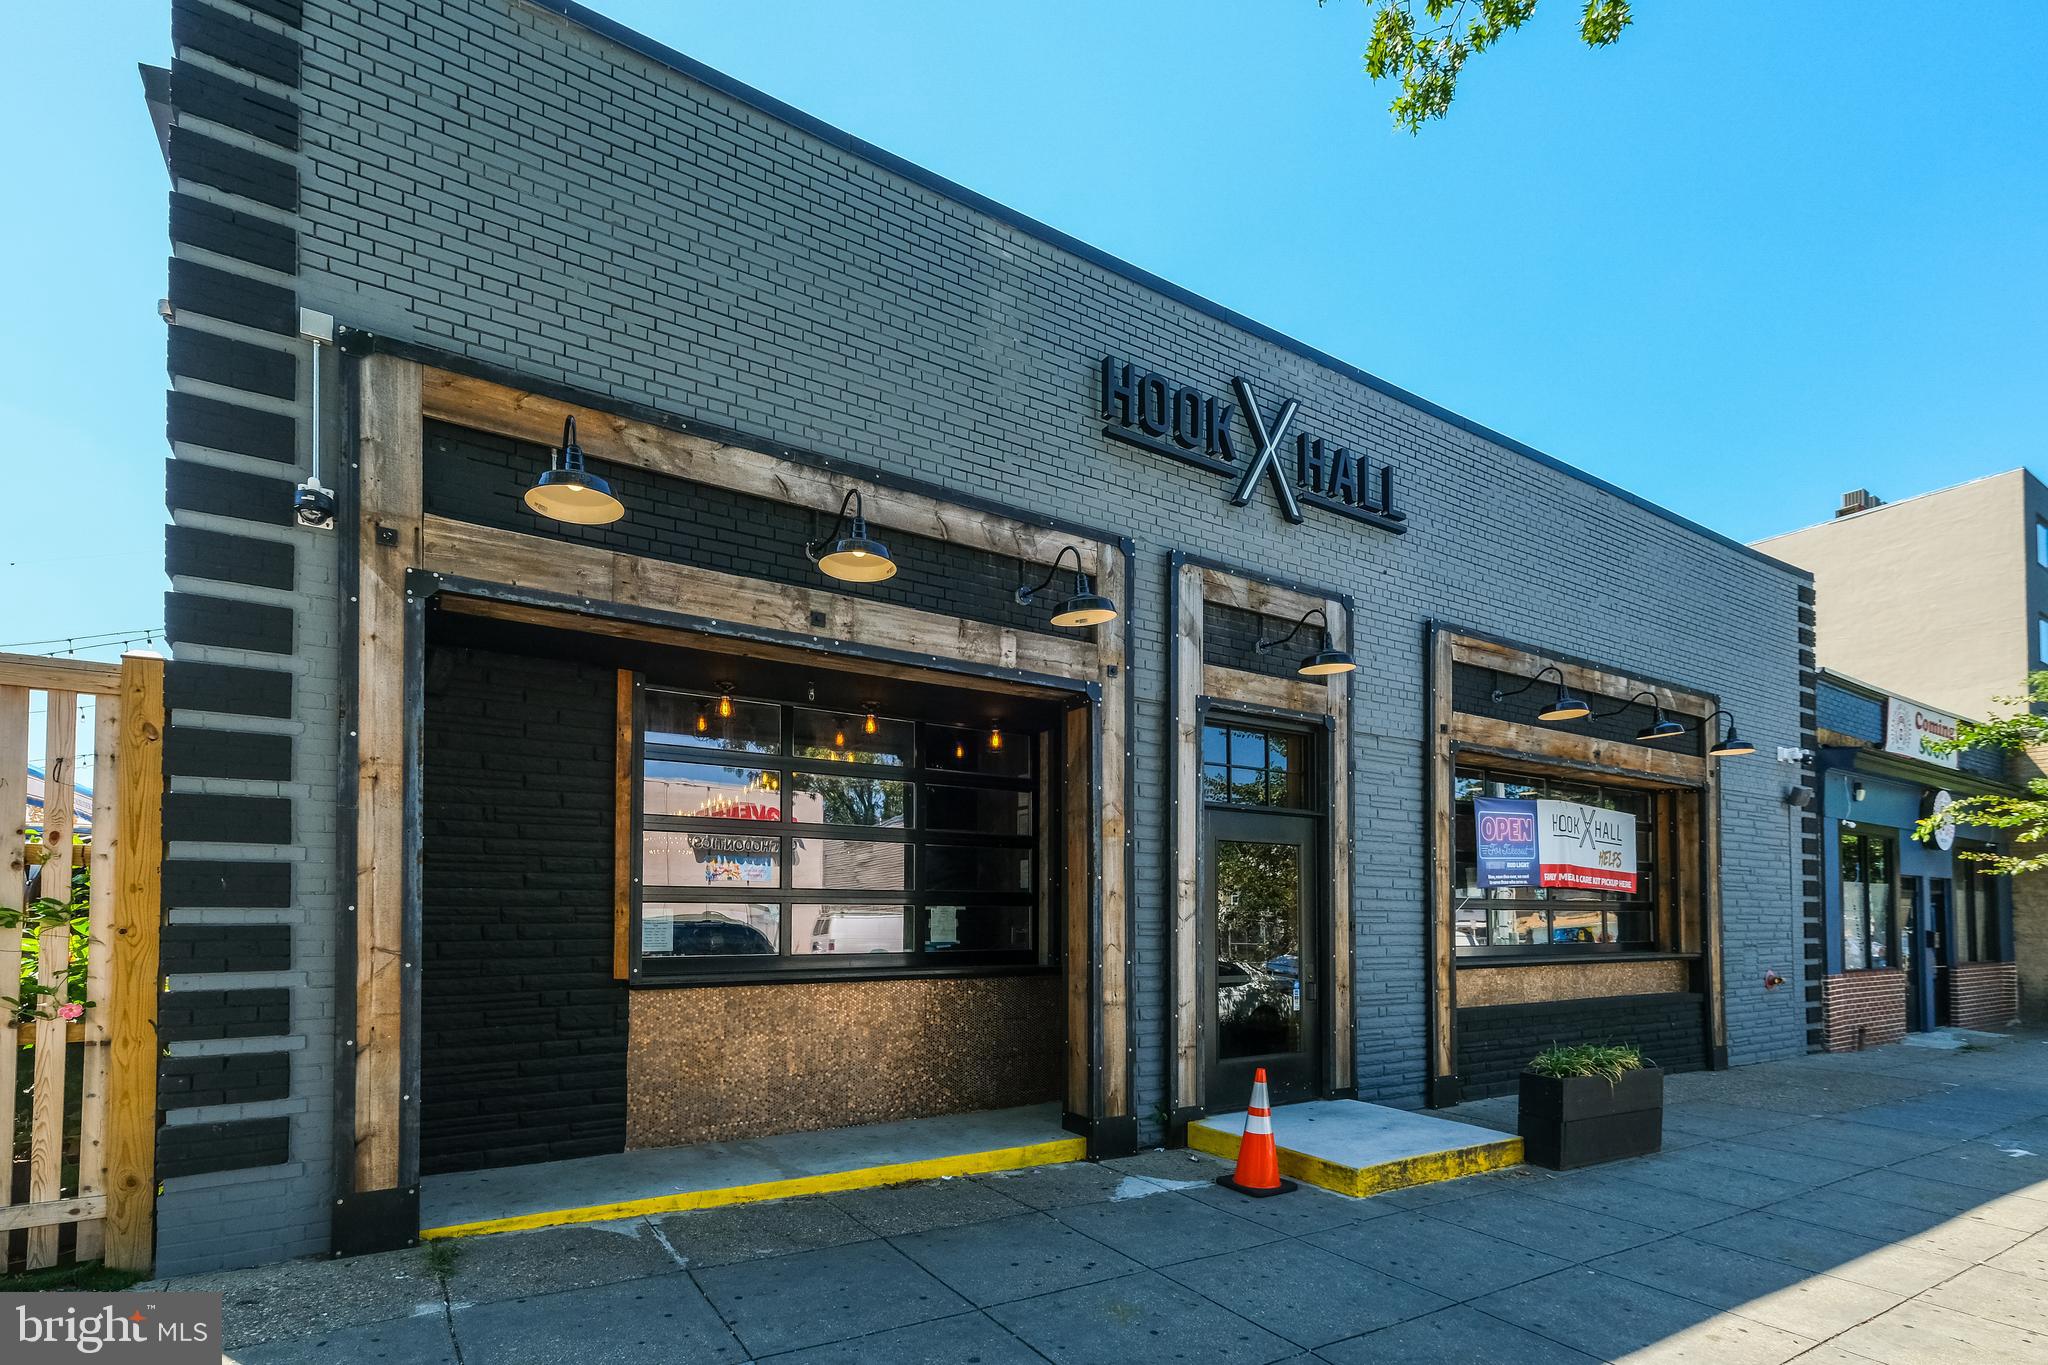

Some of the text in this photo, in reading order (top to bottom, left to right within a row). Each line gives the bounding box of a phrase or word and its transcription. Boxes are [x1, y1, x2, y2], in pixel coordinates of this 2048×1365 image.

[1101, 355, 1407, 525] HOOK X HALL
[1915, 711, 1955, 741] Coming
[1481, 816, 1533, 842] OPEN
[1552, 813, 1580, 836] HOOK
[1595, 820, 1622, 842] HALL
[1598, 850, 1622, 868] HELPS
